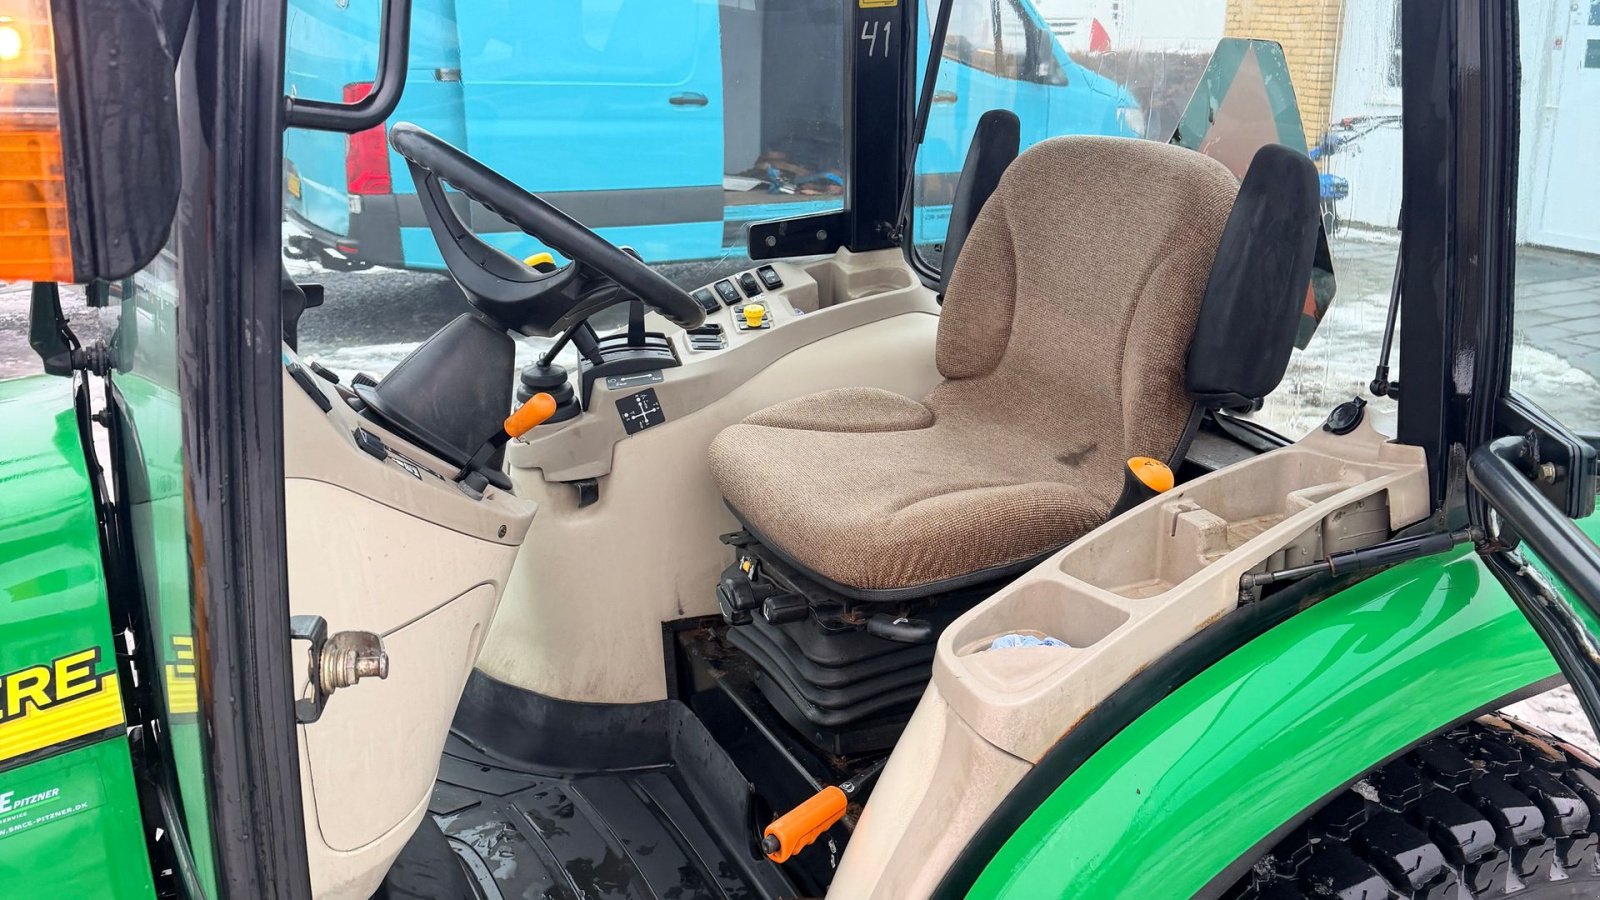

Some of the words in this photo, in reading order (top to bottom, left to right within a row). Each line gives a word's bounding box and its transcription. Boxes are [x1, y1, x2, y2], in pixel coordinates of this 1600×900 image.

[861, 21, 891, 57] 41
[0, 648, 97, 719] RE
[13, 787, 60, 809] PITZNER
